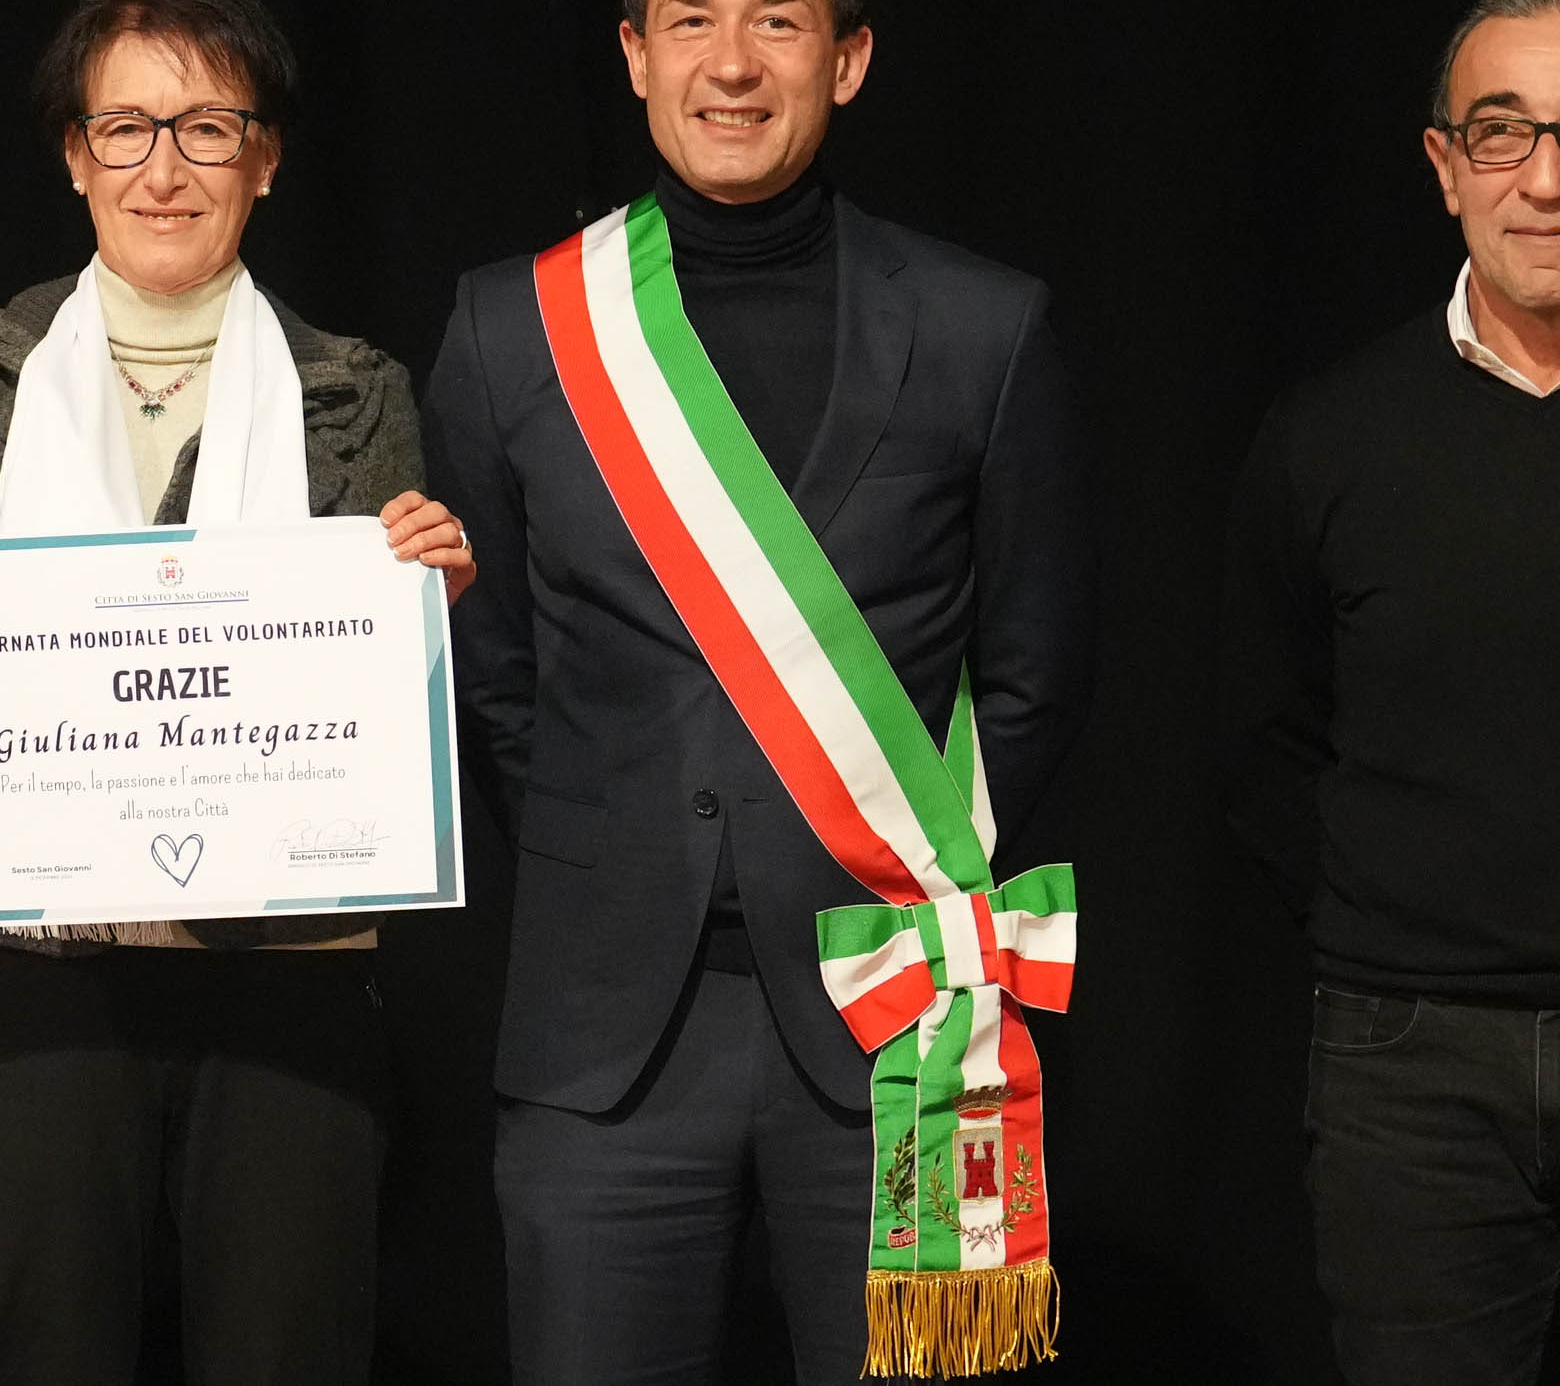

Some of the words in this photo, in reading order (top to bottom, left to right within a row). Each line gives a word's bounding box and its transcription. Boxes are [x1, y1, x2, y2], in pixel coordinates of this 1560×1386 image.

[69, 627, 169, 650] MONDIALE
[177, 625, 214, 645] DEL
[221, 617, 374, 643] VOLONTARIATO
[111, 664, 232, 703] GRAZIE
[157, 713, 359, 758] Mantegazza
[0, 772, 25, 794] Per
[26, 770, 37, 794] il
[38, 779, 87, 797] tempo,
[89, 767, 104, 791] la
[106, 772, 167, 796] passione
[168, 775, 178, 788] e
[234, 760, 260, 784] che
[262, 760, 284, 783] hai
[286, 758, 347, 782] dedicato
[118, 797, 144, 821] alla
[146, 804, 191, 820] nostra
[288, 852, 328, 862] Roberto
[338, 849, 377, 860] Stefano
